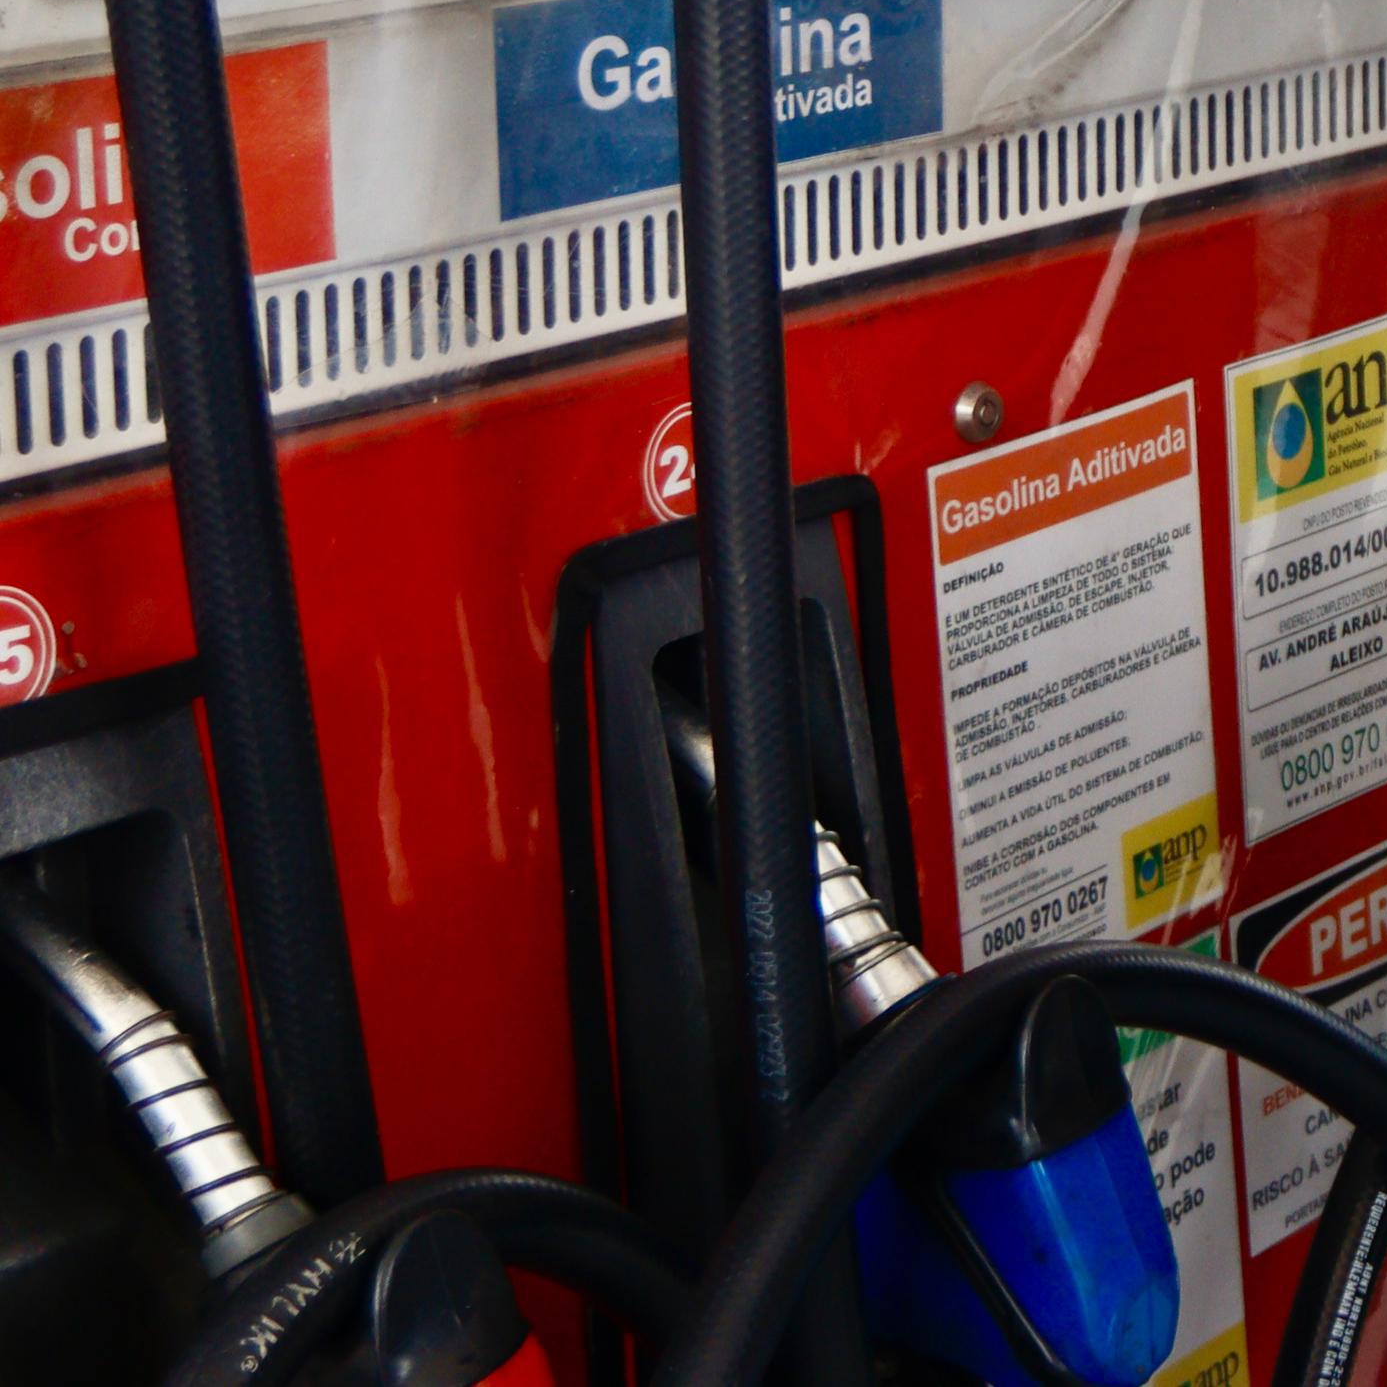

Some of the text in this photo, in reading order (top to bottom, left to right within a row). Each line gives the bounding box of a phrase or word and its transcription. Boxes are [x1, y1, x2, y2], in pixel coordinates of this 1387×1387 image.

[660, 445, 696, 498] 2
[942, 425, 1186, 534] Gasolina Aditivada
[943, 561, 1004, 594] DEFINIÇÃO
[947, 605, 1020, 640] PROPORCIONA
[1022, 600, 1030, 611] A
[1031, 584, 1072, 607] LIMPEZA
[1076, 577, 1089, 591] DE
[1092, 565, 1118, 584] TODO
[1121, 561, 1128, 573] O
[948, 634, 1019, 670] CARBURADOR
[1022, 628, 1029, 640] E
[1031, 609, 1073, 636] CÂMERA
[1076, 604, 1089, 619] DE
[1258, 648, 1280, 670] AV.
[1285, 622, 1336, 659] ANDRÉ
[1330, 635, 1383, 670] ALEIXO
[950, 661, 1028, 700] PROPRIEDADE
[953, 626, 1190, 734] IMPEDE A FORMAÇÃO DEPÓSITOS NA VÁLVULA DE
[1280, 742, 1334, 791] 0800
[1341, 722, 1380, 764] 970
[1162, 824, 1208, 870] anp
[982, 917, 1026, 955] 0800
[1029, 899, 1063, 931] 970
[1067, 877, 1109, 913] 0267
[1170, 1141, 1216, 1189] pode
[1252, 1168, 1304, 1212] RISCO
